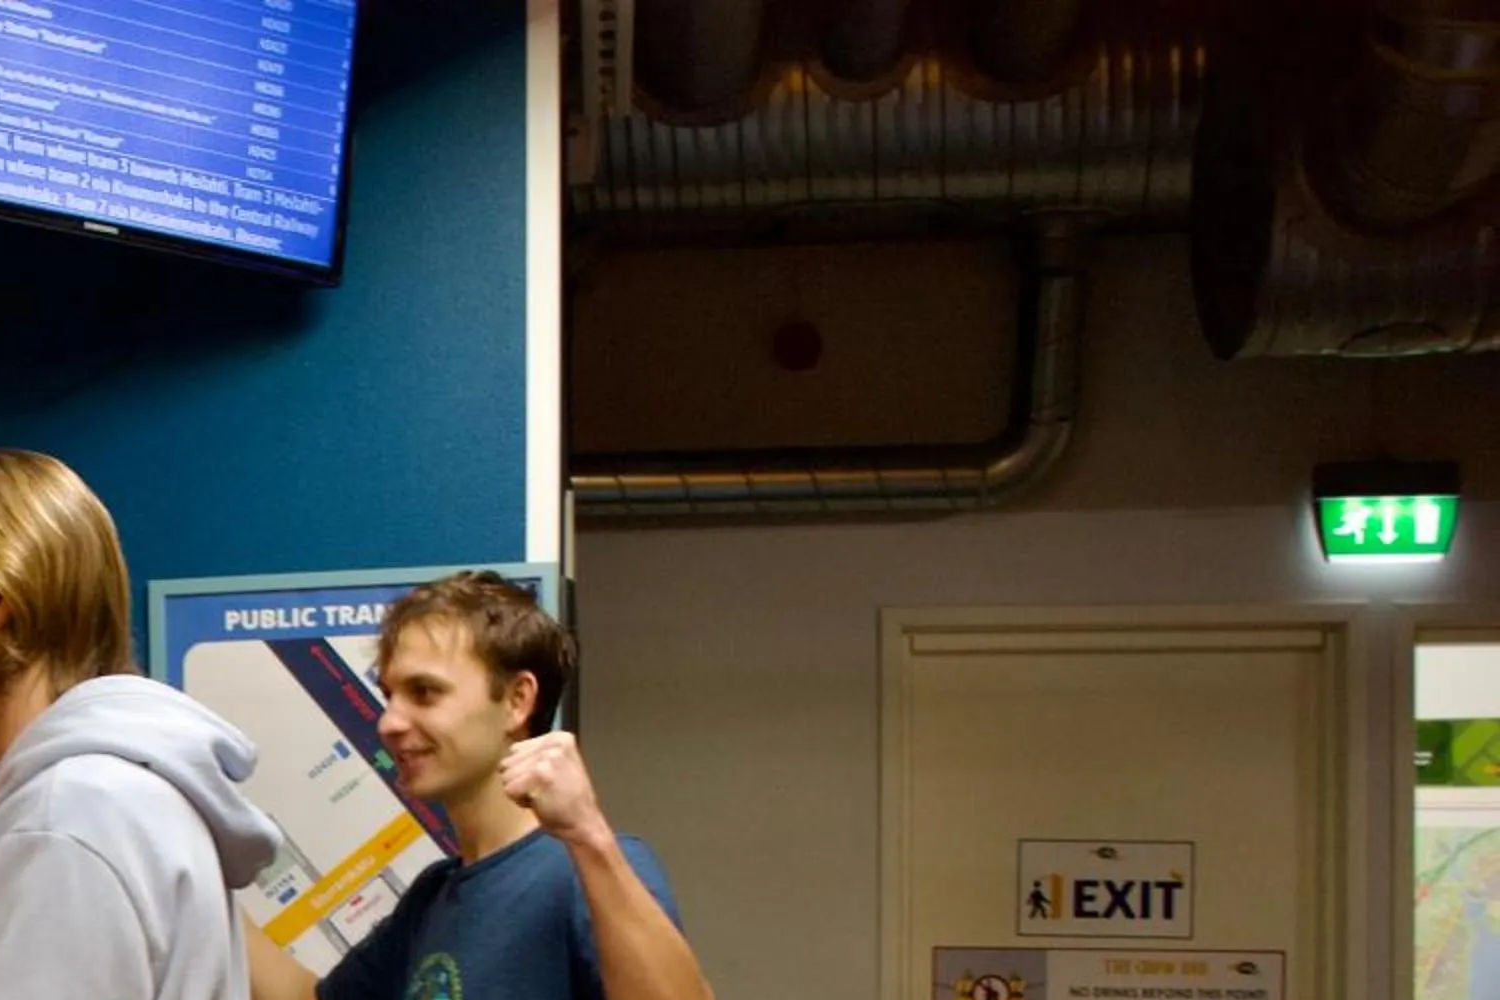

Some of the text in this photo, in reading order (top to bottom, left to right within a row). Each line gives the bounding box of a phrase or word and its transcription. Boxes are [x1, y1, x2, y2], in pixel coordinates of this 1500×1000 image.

[224, 607, 318, 632] PUBLIC
[1073, 879, 1184, 920] EXIT
[1069, 986, 1089, 998] NO
[1142, 987, 1193, 999] BEYOND
